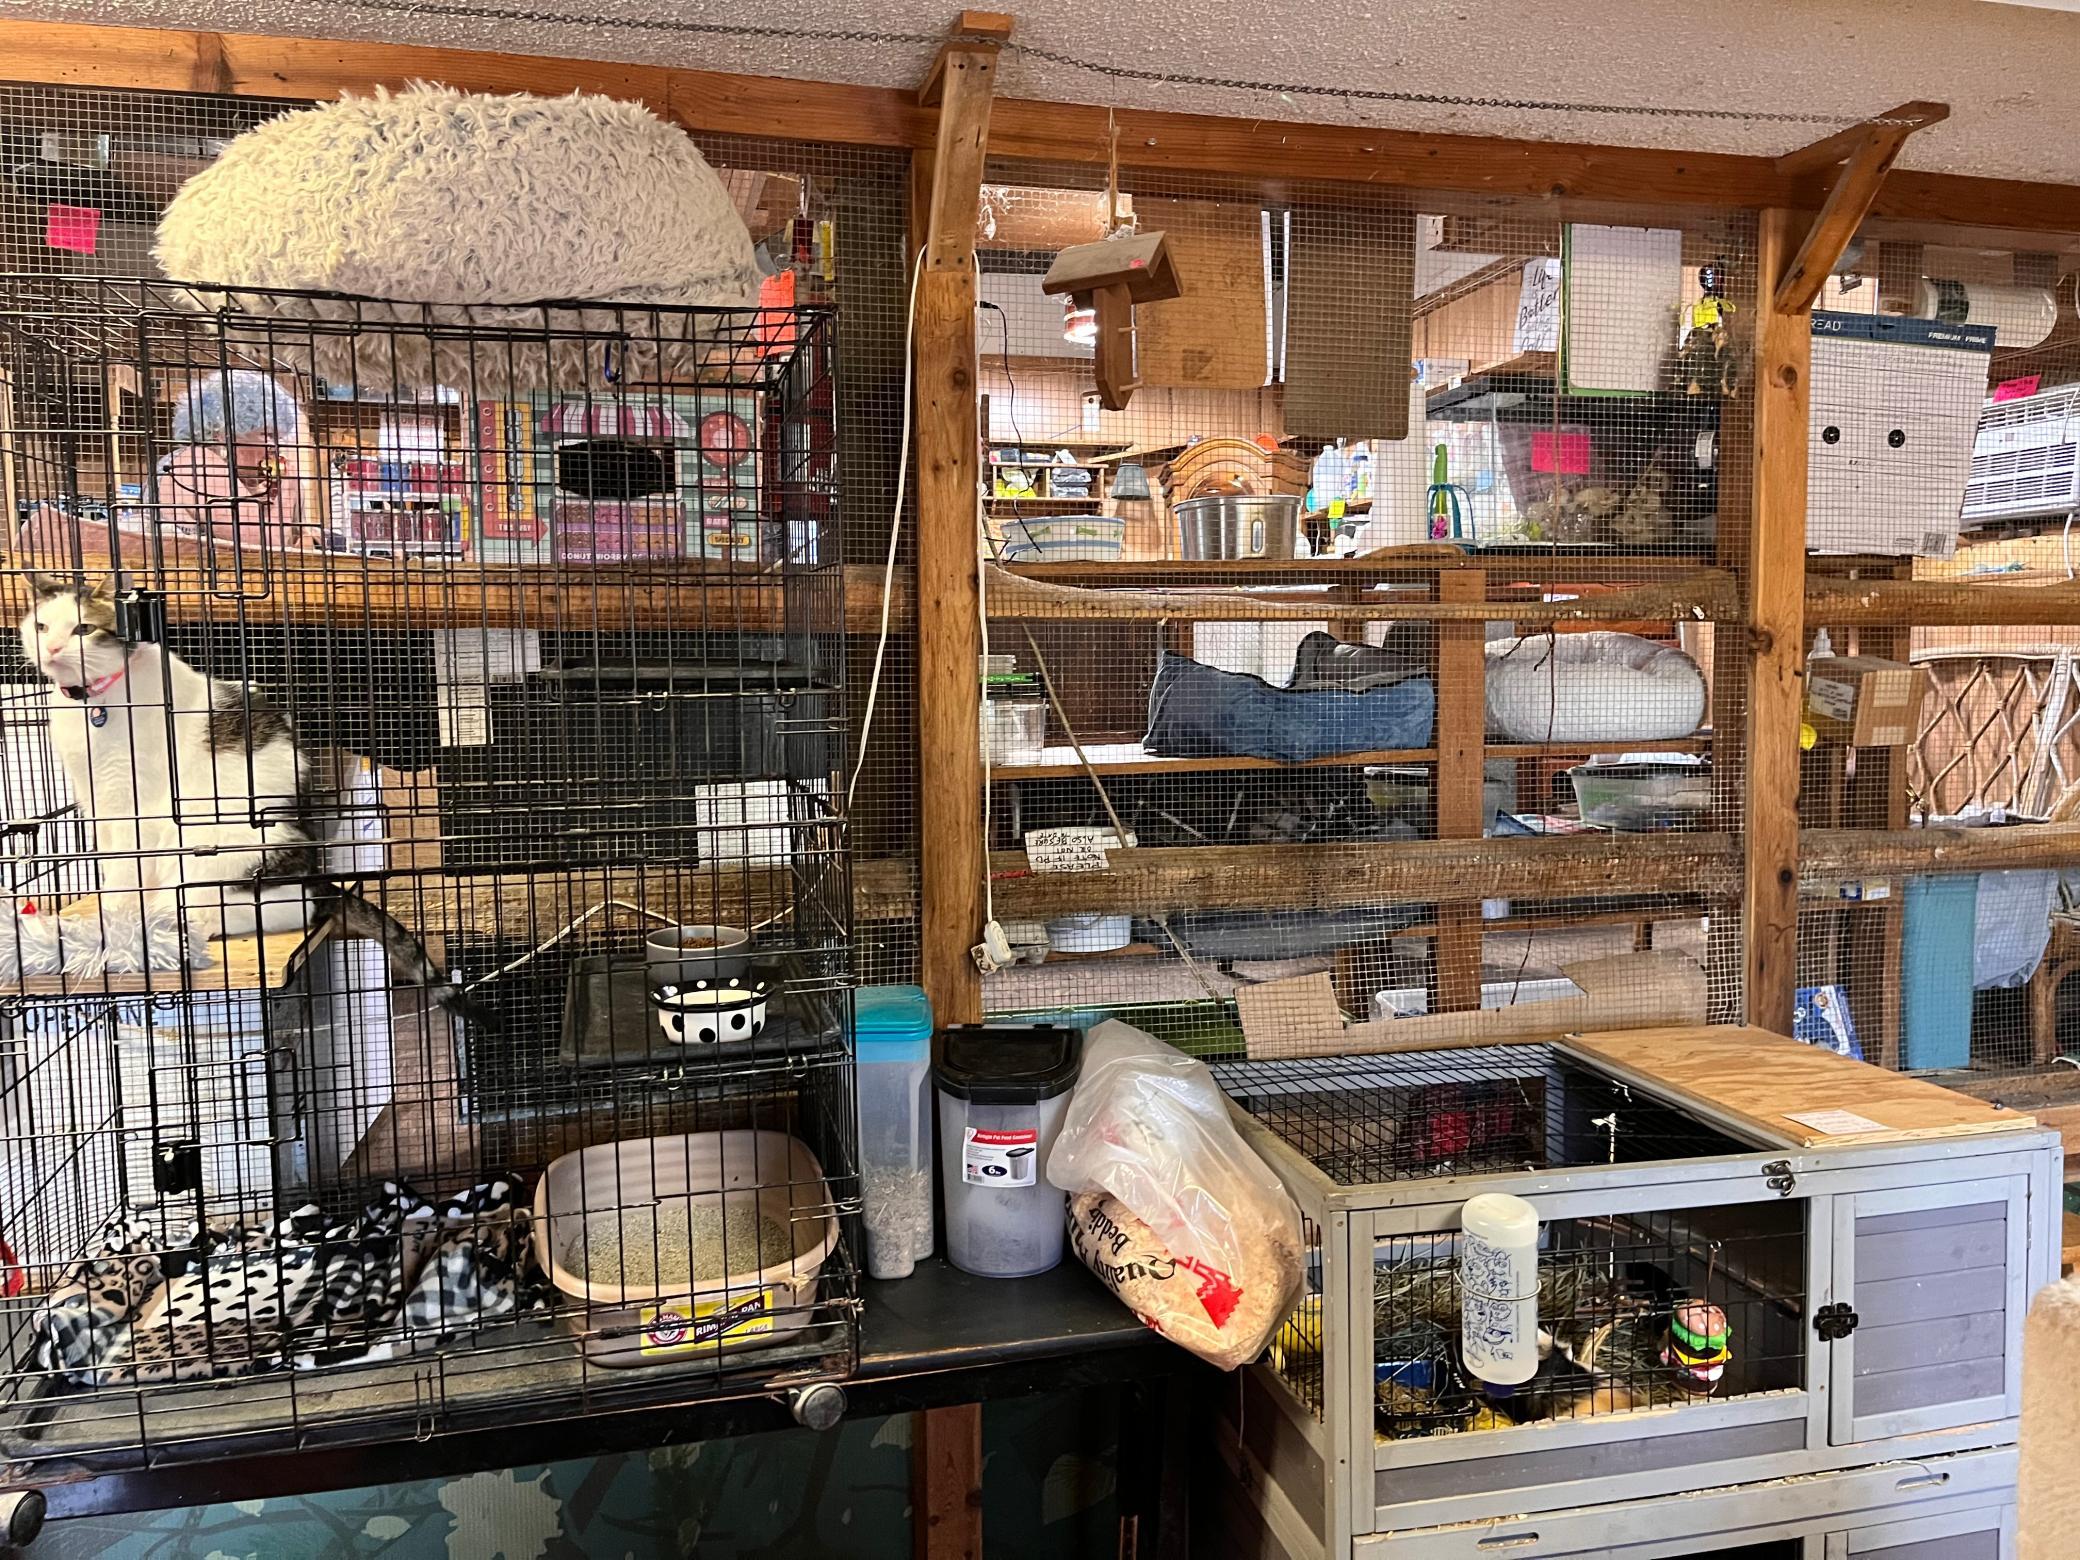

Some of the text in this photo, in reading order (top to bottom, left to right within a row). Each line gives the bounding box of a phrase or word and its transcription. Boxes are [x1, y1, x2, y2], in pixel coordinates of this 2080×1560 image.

[561, 552, 592, 560] DONUT
[1071, 835, 1095, 844] ALSO
[1056, 846, 1074, 854] NOT
[1074, 853, 1101, 862] NOTE
[988, 1165, 996, 1175] 6
[1093, 1245, 1177, 1292] Quality
